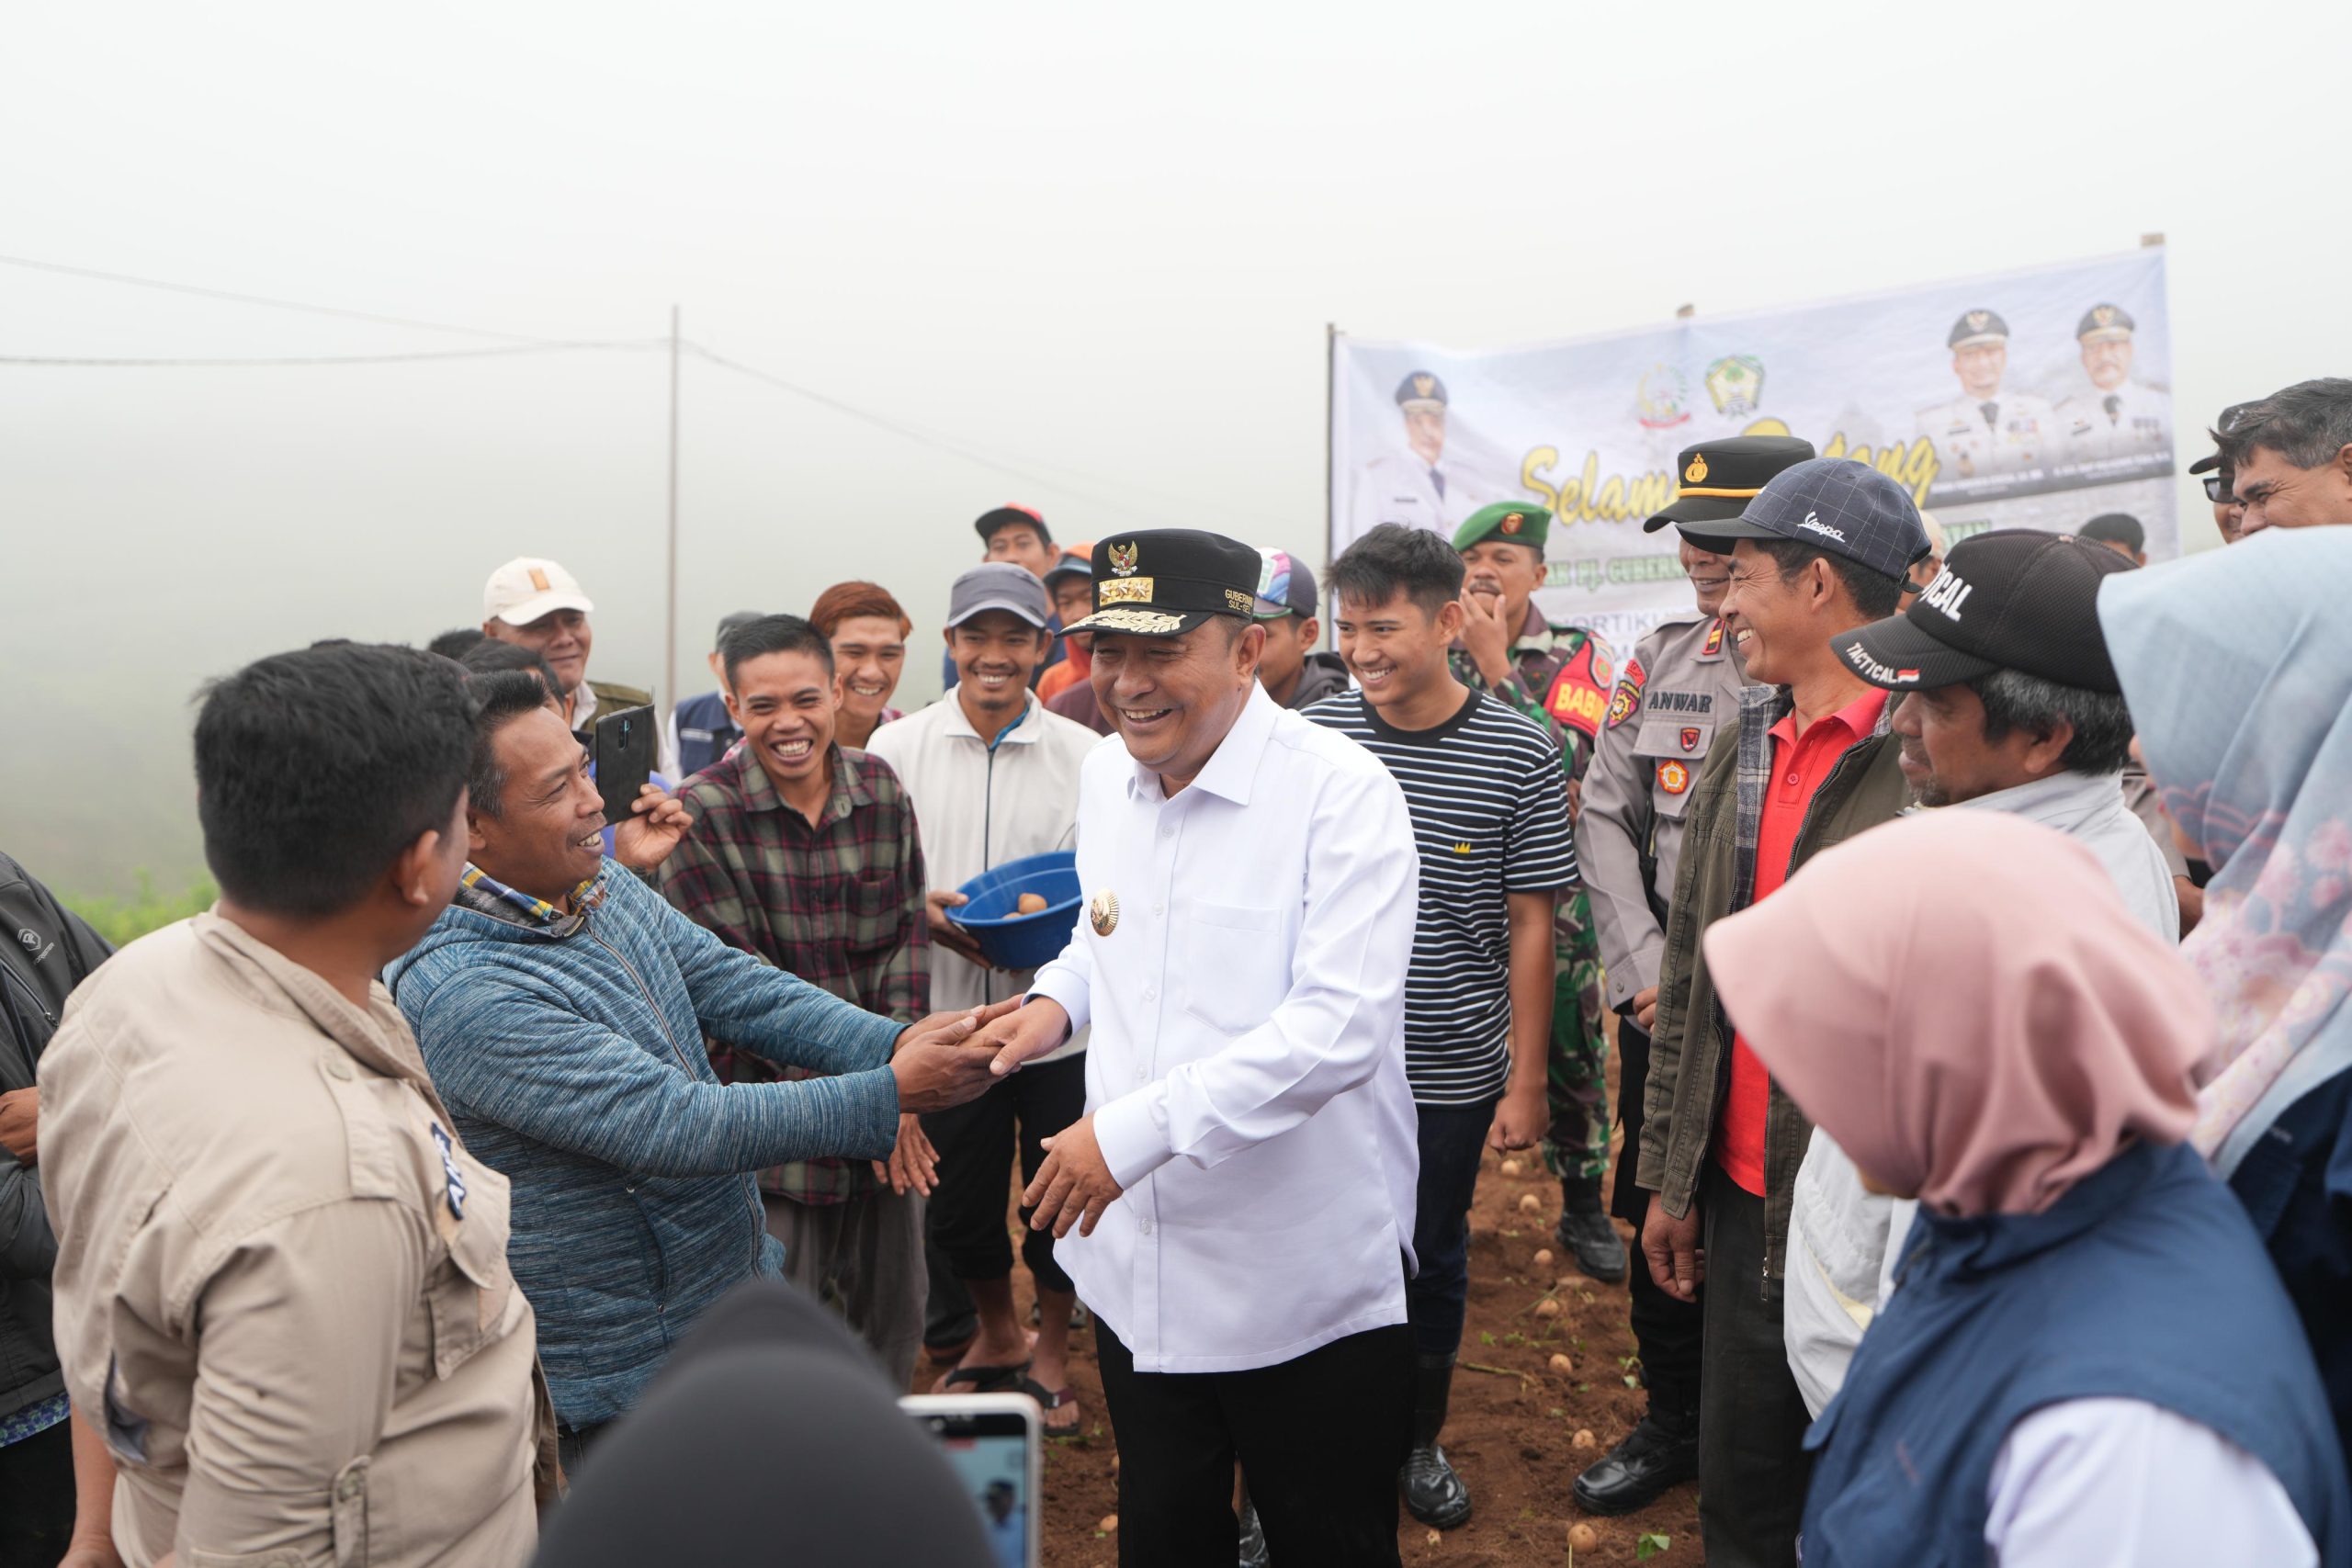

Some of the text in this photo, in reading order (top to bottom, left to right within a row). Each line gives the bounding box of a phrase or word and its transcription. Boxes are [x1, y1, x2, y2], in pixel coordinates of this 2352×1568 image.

[1521, 445, 1681, 527] Selam
[1798, 511, 1846, 543] Vespa
[1846, 642, 1899, 684] TACTICAL
[1647, 690, 1713, 714] ANWAR
